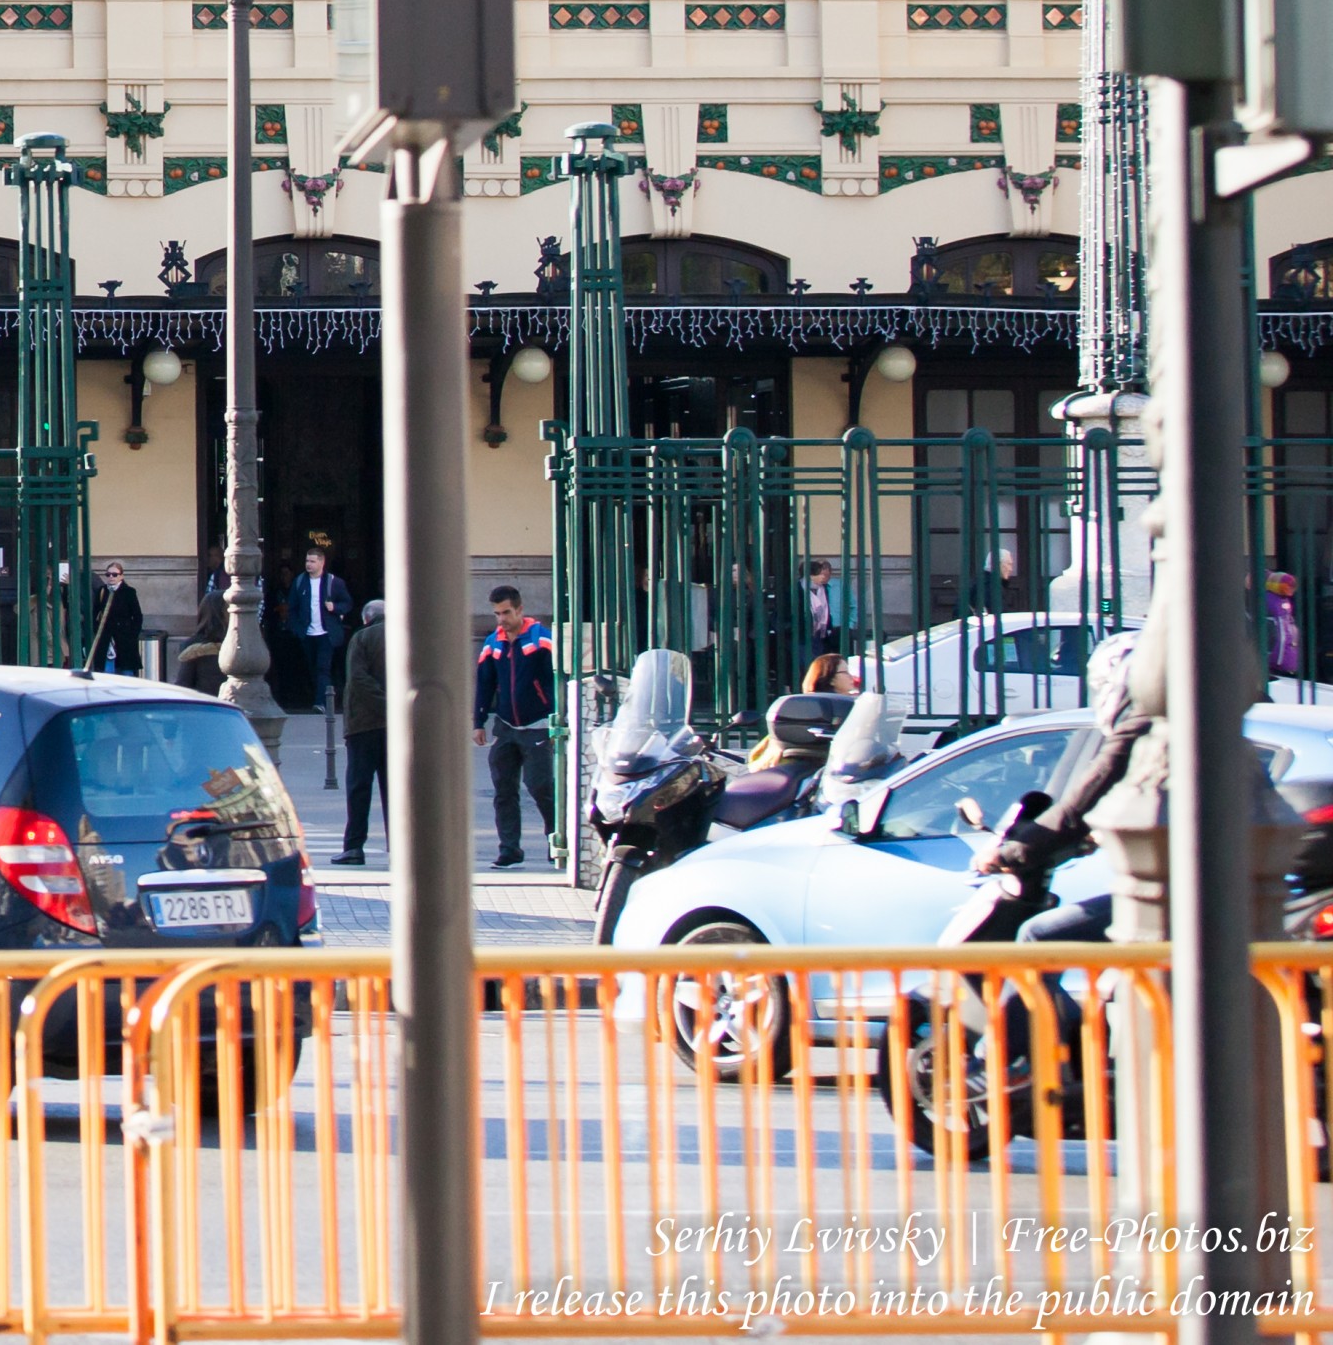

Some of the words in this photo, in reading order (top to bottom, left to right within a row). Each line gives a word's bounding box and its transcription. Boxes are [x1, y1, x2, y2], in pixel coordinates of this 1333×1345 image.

[89, 854, 124, 865] A150
[165, 896, 210, 921] 2286
[212, 894, 247, 920] FRJ
